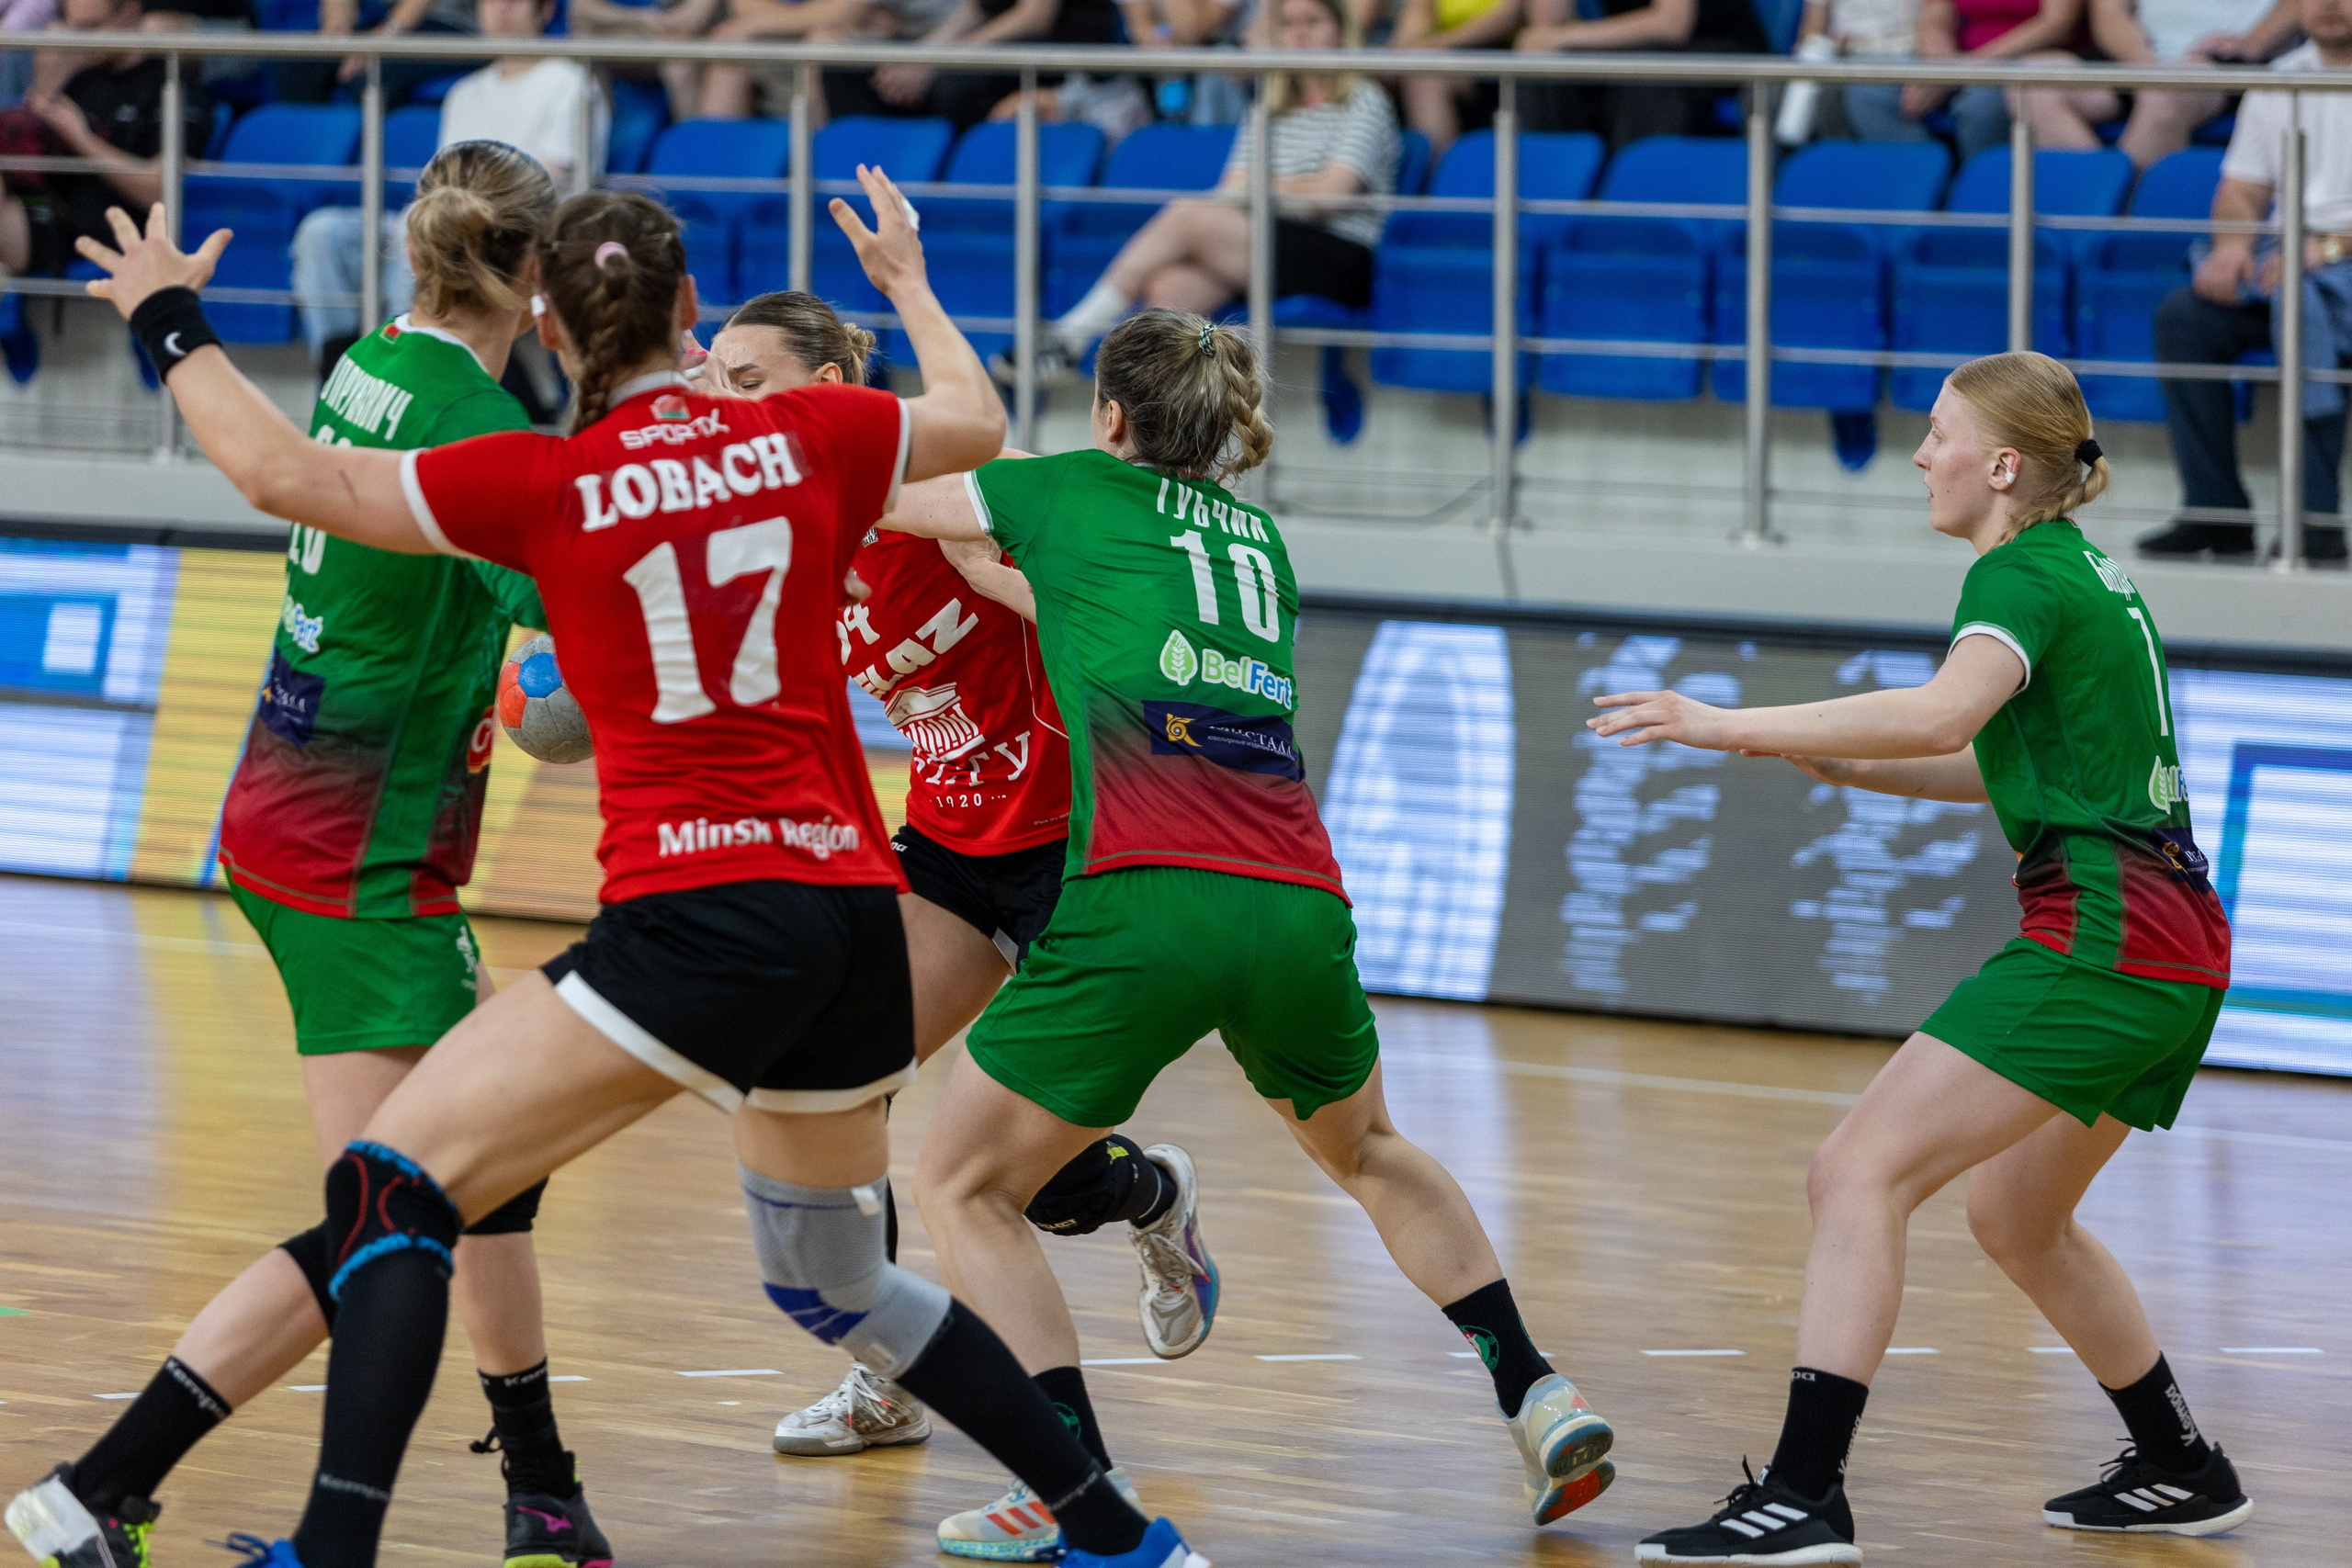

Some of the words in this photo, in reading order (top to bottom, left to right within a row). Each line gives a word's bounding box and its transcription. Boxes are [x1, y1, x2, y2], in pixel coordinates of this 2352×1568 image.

[574, 432, 802, 533] LOBACH
[622, 515, 793, 725] 17
[1170, 529, 1281, 643] 10
[1203, 649, 1291, 709] BelFert
[657, 816, 774, 858] Minsk
[777, 815, 860, 861] Region
